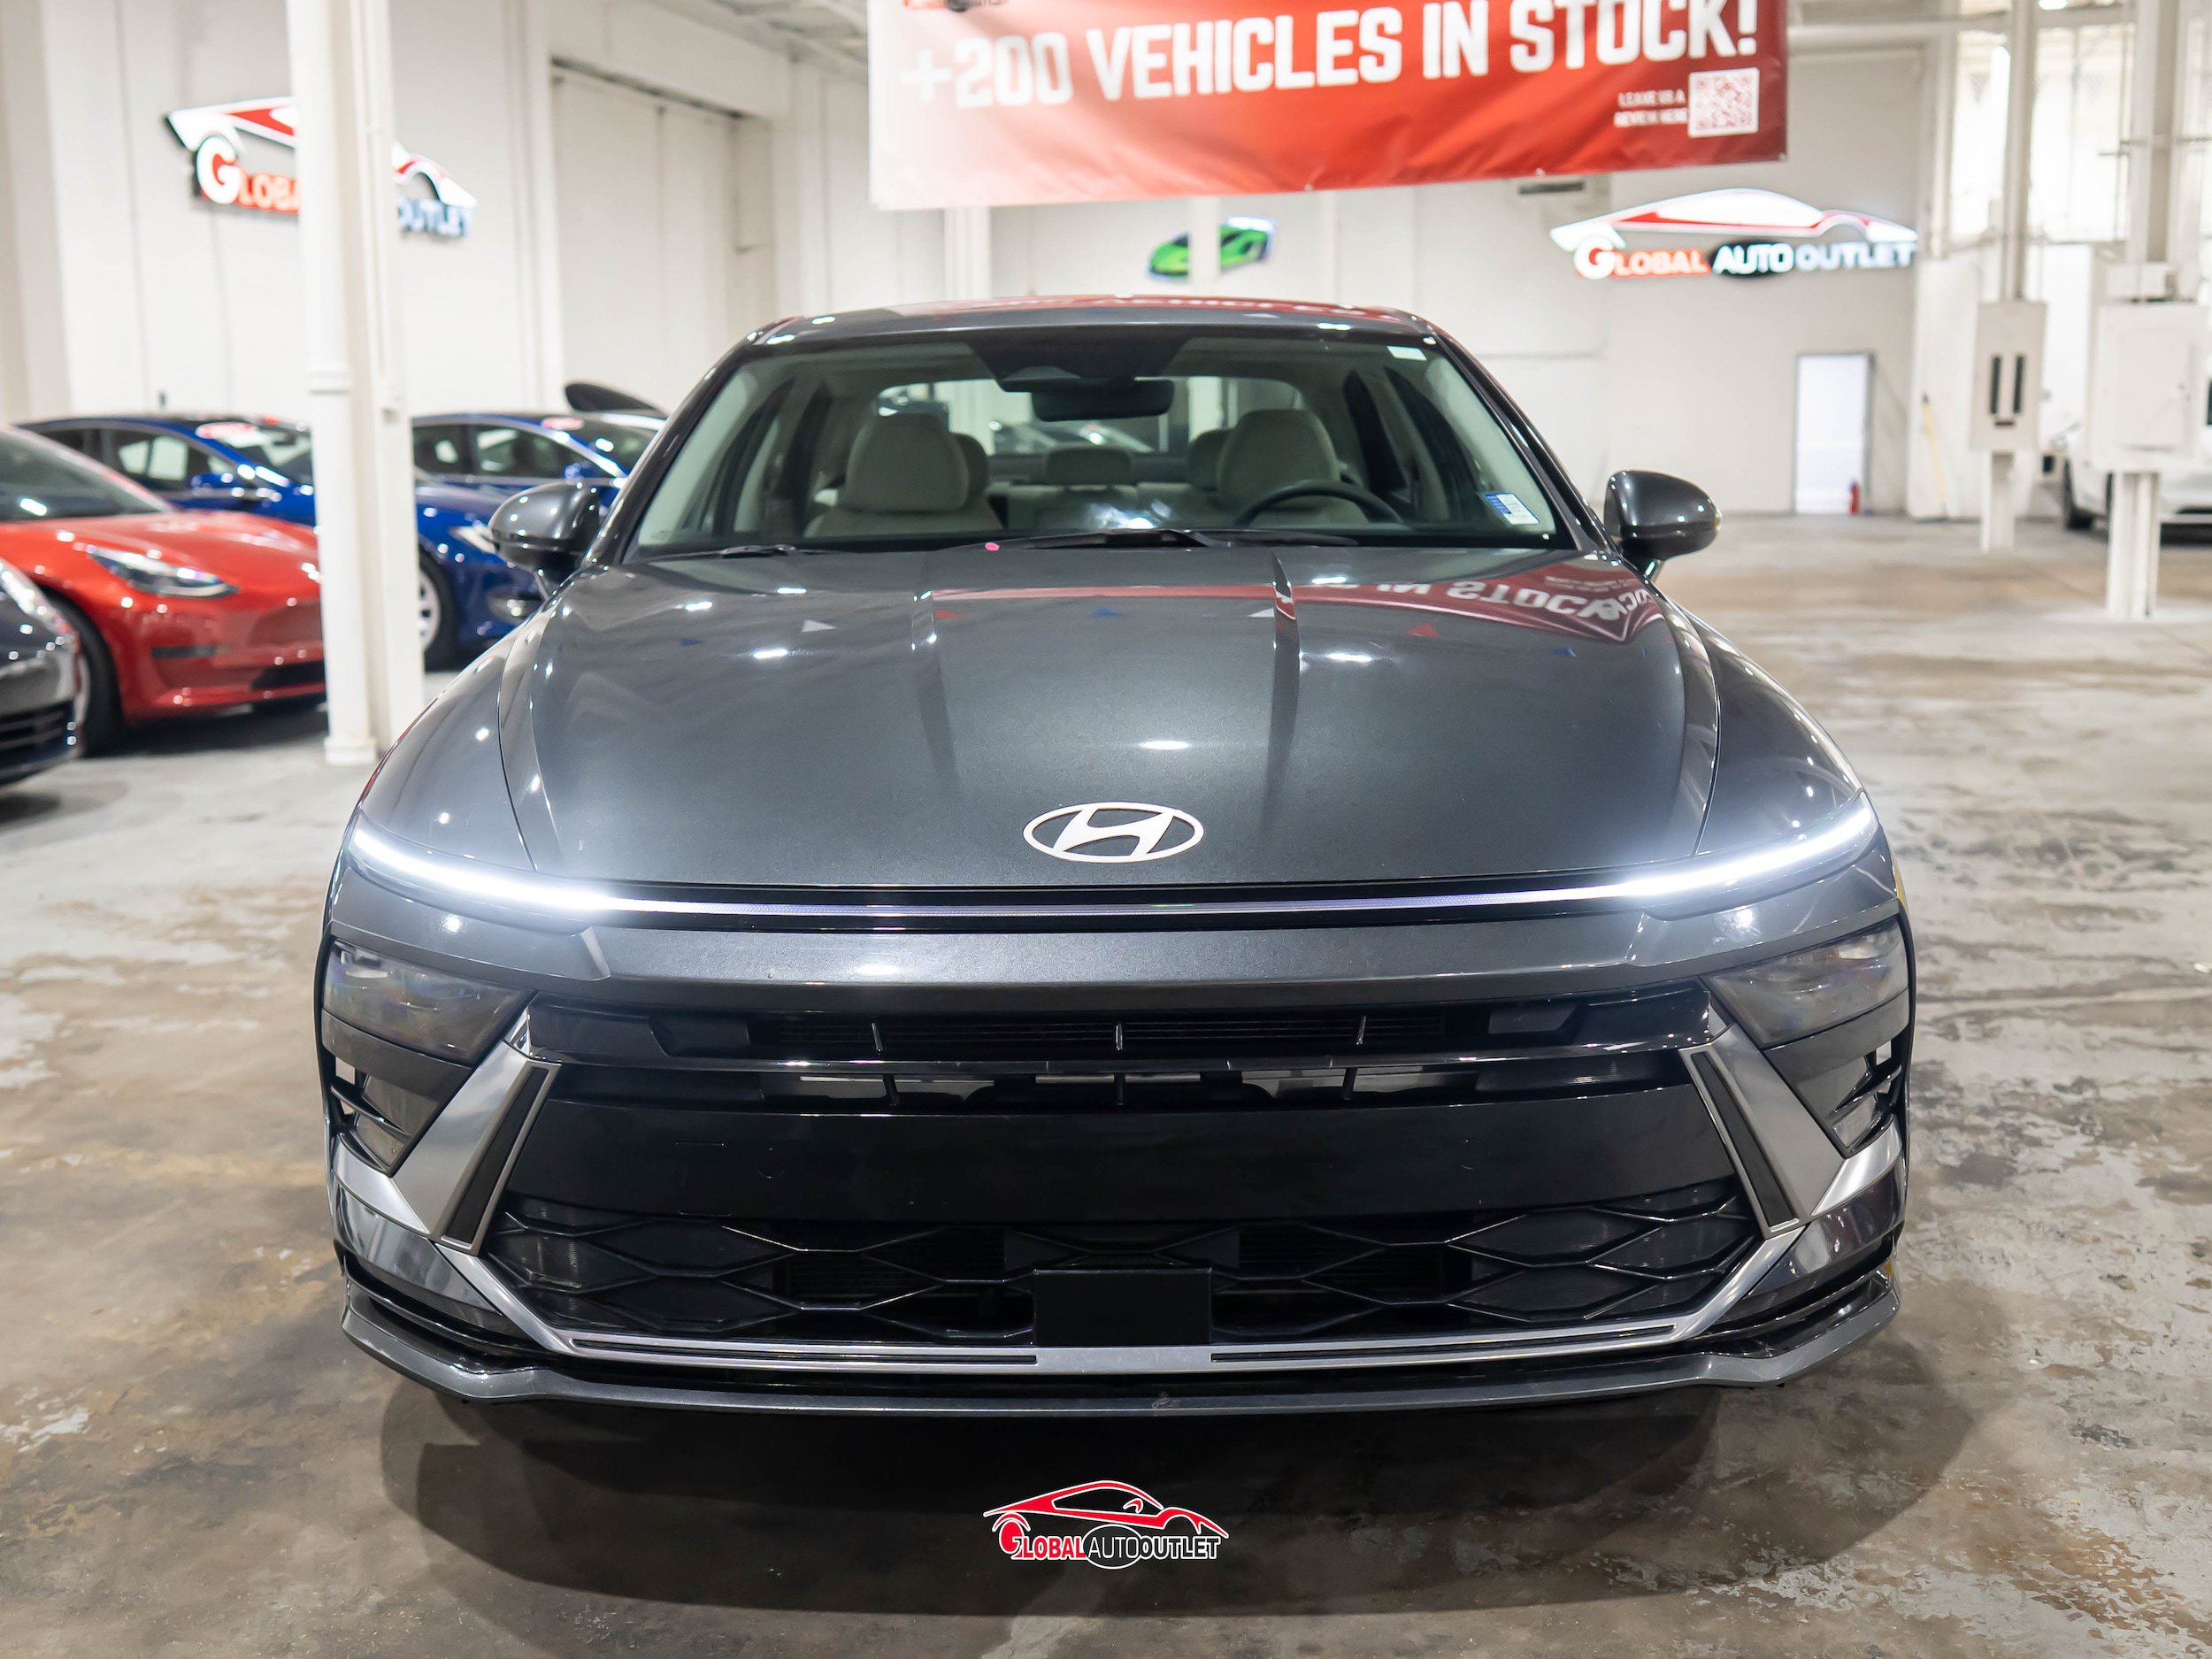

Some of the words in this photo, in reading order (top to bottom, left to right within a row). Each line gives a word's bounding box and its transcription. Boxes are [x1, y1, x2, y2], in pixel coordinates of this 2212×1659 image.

[1085, 7, 1402, 101] VEHICLES
[1422, 0, 1488, 79] IN
[1509, 0, 1757, 73] STOCK!
[1573, 235, 1711, 280] GLOBAL
[1712, 242, 1794, 274] AUTO
[1795, 242, 1917, 269] OUTLET
